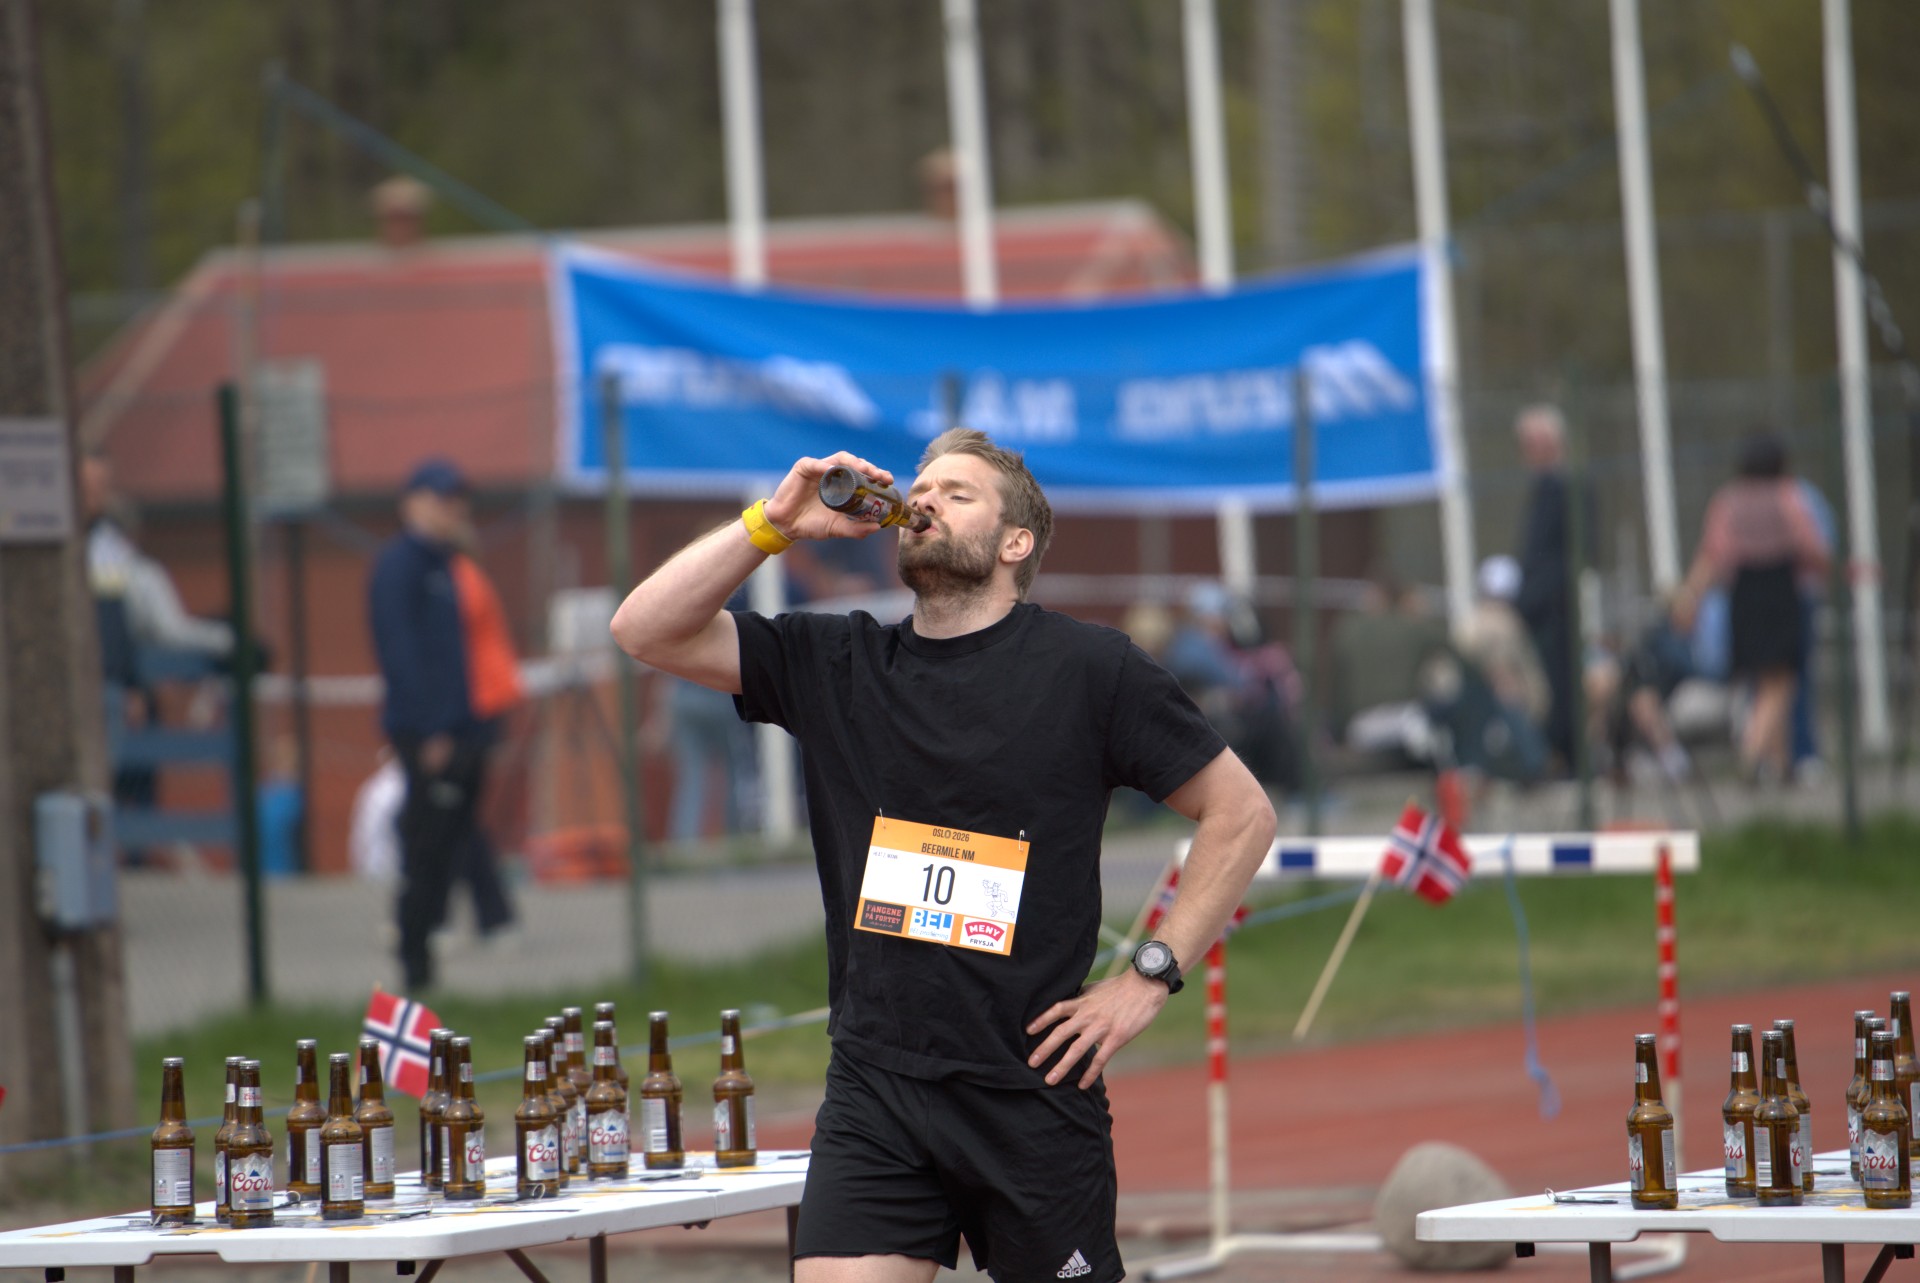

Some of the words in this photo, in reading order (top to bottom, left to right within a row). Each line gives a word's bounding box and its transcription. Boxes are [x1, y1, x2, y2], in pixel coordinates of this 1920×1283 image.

[933, 828, 951, 839] OSLO
[952, 831, 970, 842] 2026
[921, 842, 960, 858] BEERMILE
[962, 849, 975, 861] NM
[922, 863, 956, 905] 10
[969, 924, 1000, 937] MENY
[970, 938, 994, 947] FRYSJA
[527, 1143, 558, 1163] Coo
[1863, 1153, 1896, 1169] oors
[1057, 1264, 1092, 1278] adidas
